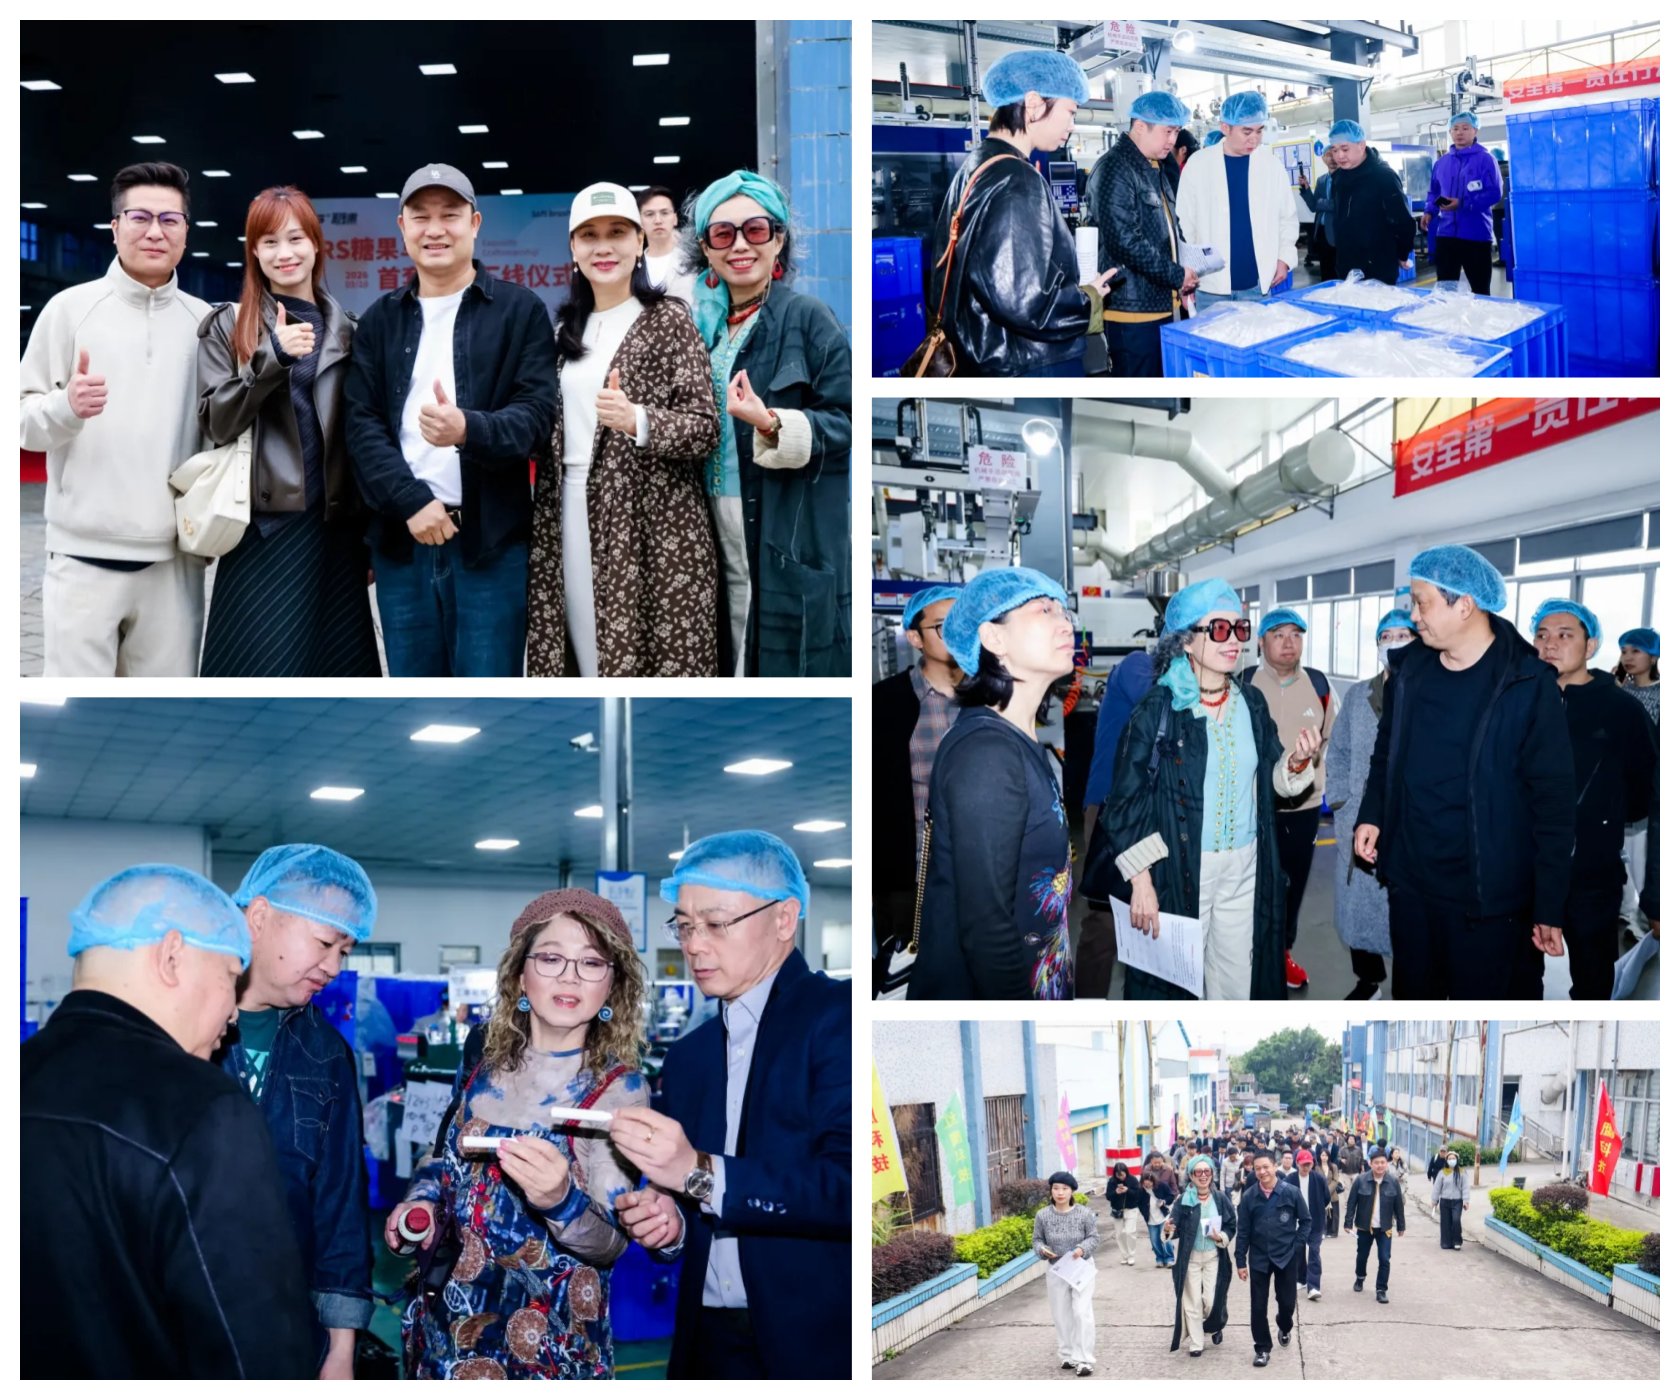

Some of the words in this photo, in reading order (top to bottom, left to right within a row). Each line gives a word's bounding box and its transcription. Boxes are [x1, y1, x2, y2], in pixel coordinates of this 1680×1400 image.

[1508, 66, 1660, 98] 安全第一责任行
[1410, 398, 1660, 481] 安全第一责任
[978, 451, 1016, 468] 危险
